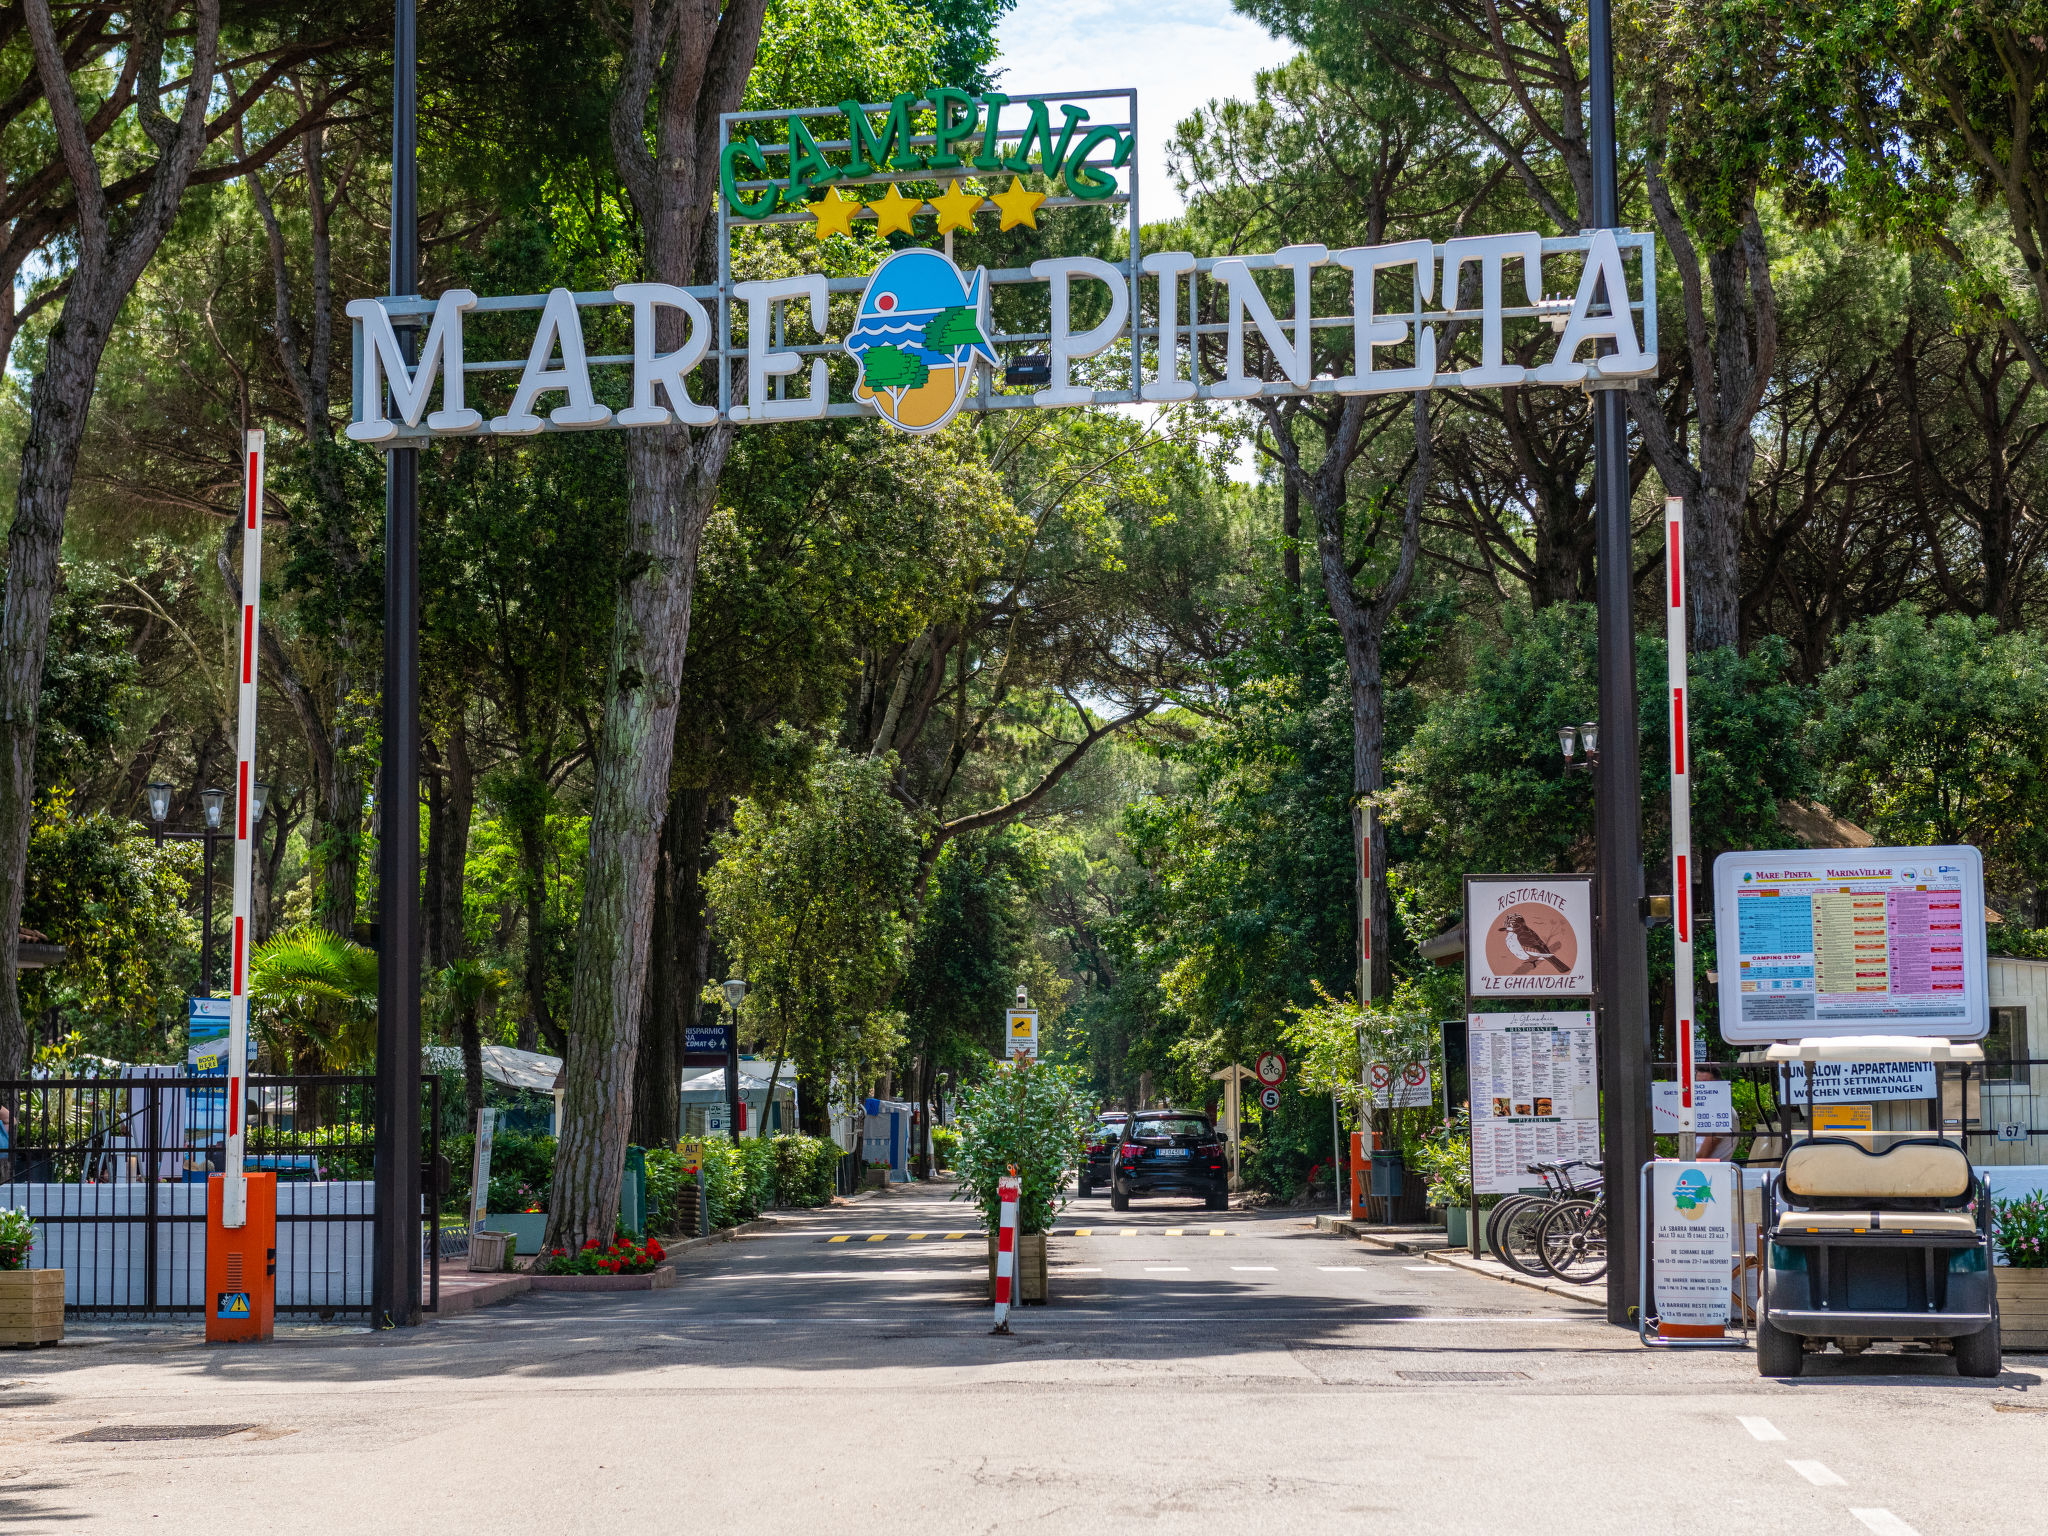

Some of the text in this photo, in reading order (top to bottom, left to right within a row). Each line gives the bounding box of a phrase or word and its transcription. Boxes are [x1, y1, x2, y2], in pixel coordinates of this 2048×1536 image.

[720, 86, 1135, 221] CAMPING
[345, 229, 1658, 443] MARE PINETA
[1756, 870, 1812, 879] MARE PINETA
[1827, 868, 1893, 877] MARINA VILLAGE
[1498, 888, 1567, 912] RISTORANTE
[1851, 1061, 1932, 1075] APPARTAMENTI
[1844, 1075, 1912, 1086] SETTIMANALI
[1843, 1084, 1923, 1096] VERMIETUNGEN
[1266, 1092, 1276, 1105] 5
[2006, 1126, 2018, 1137] 67
[685, 1144, 699, 1152] ALT
